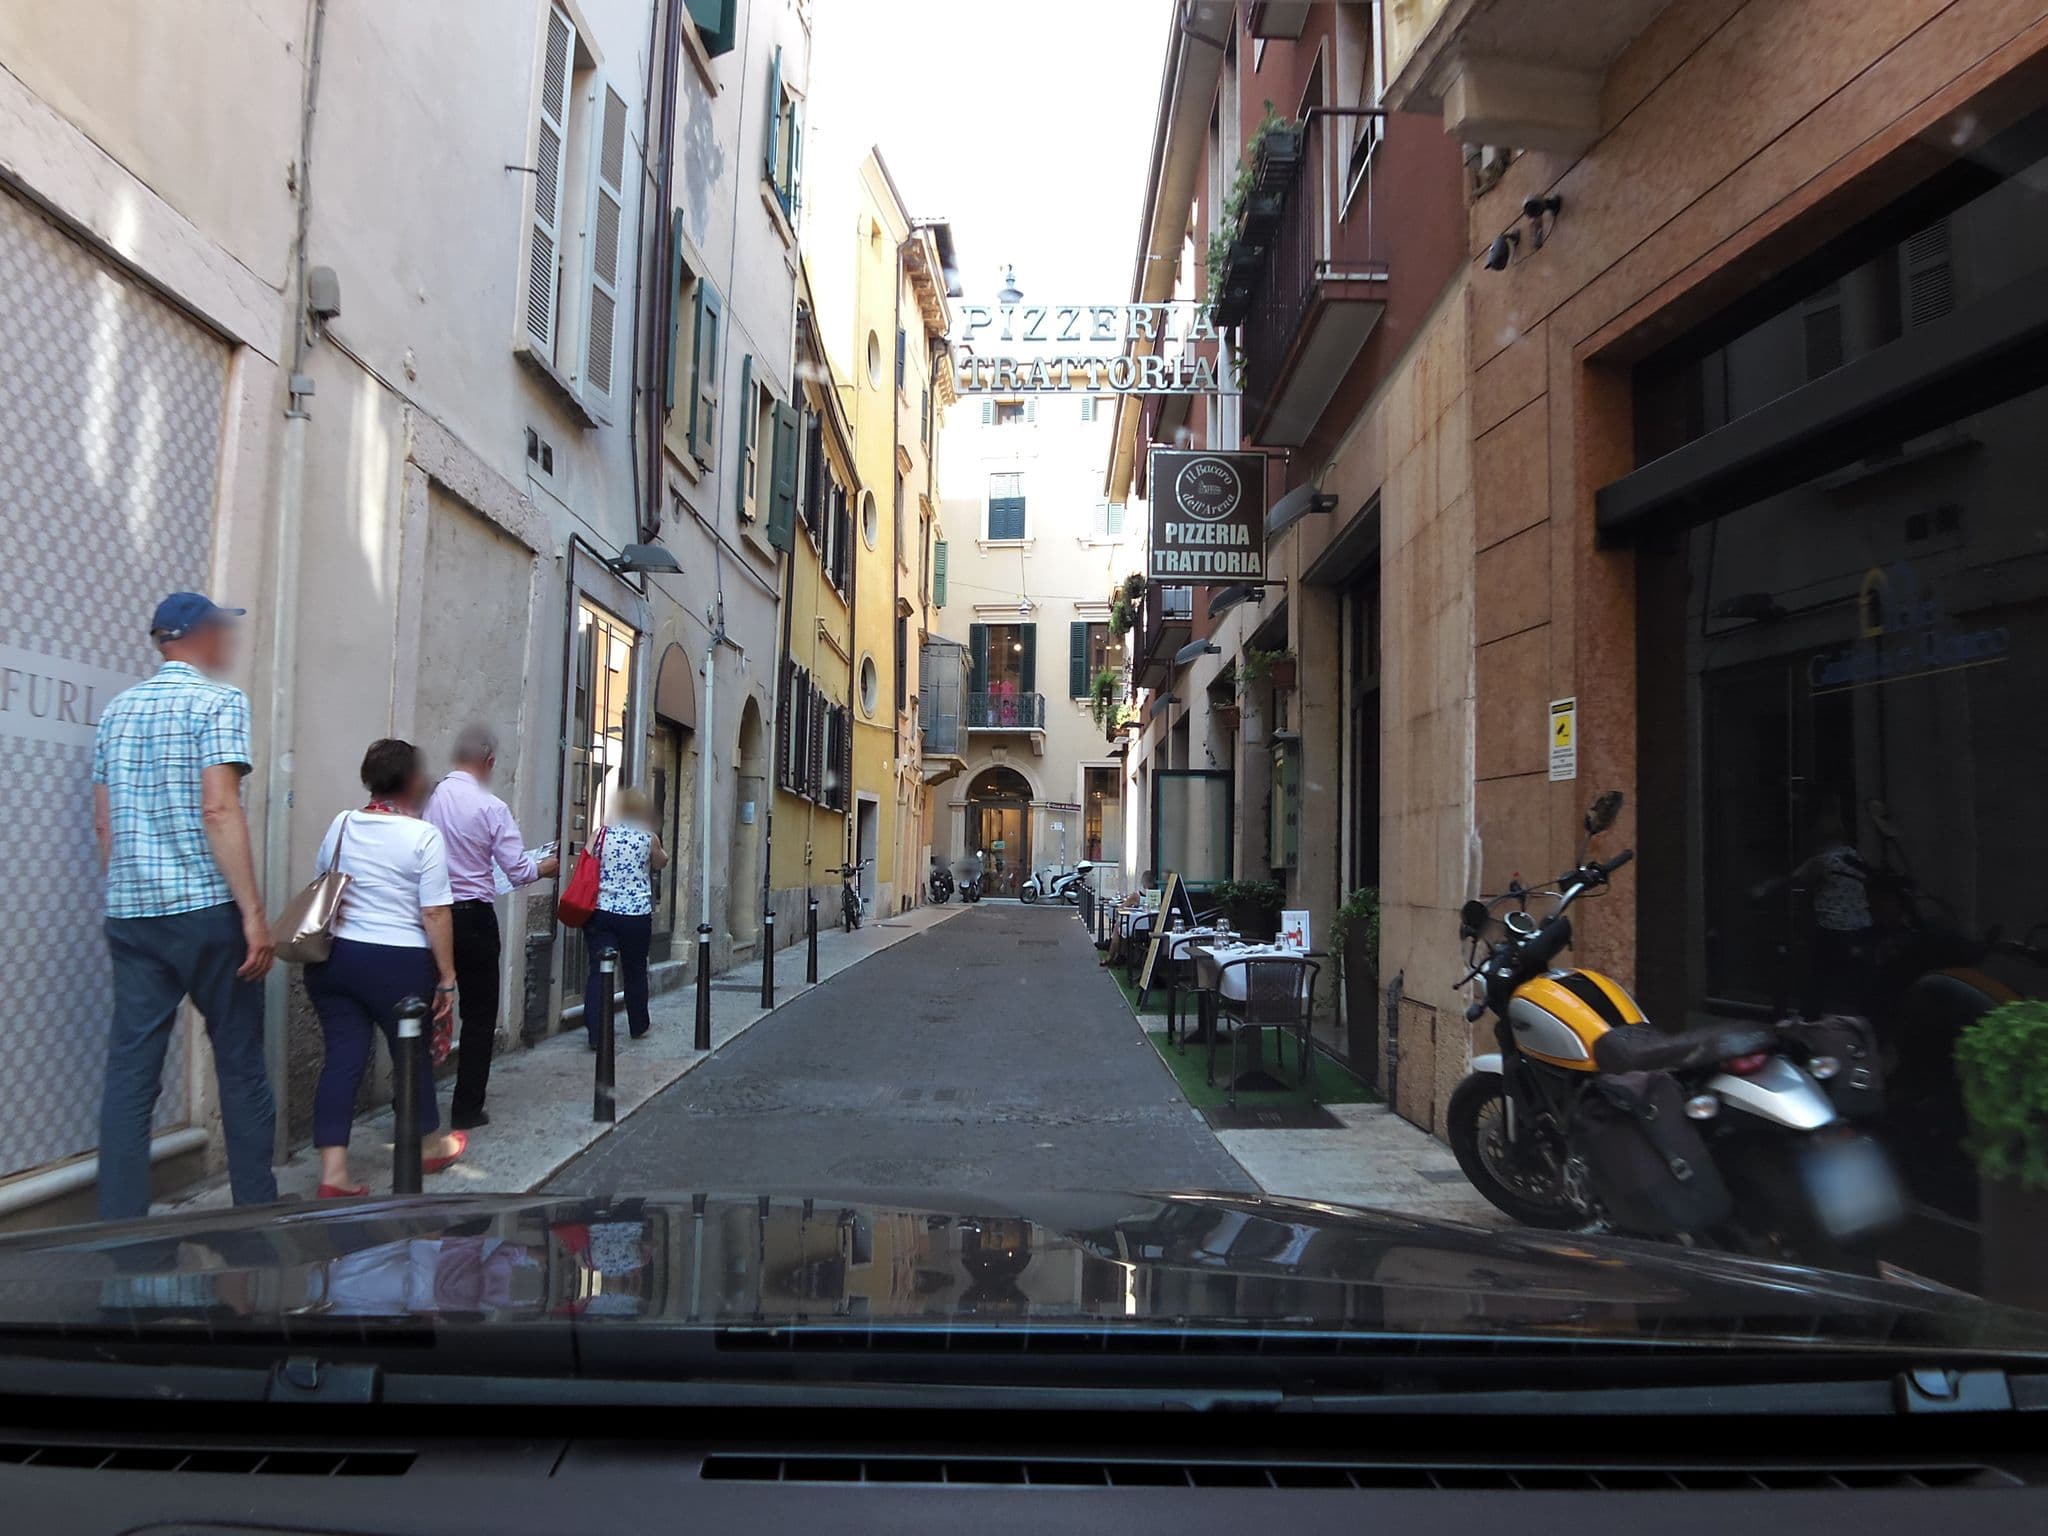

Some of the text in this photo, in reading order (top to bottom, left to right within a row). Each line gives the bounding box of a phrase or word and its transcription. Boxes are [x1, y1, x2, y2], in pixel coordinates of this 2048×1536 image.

[960, 305, 1219, 342] PIZZERIA
[959, 356, 1218, 391] TRATTORIA
[1195, 464, 1233, 485] Bacaro
[1182, 493, 1235, 515] dell'Arena
[1165, 522, 1250, 545] PIZZERIA
[1154, 550, 1261, 573] TRATTORIA
